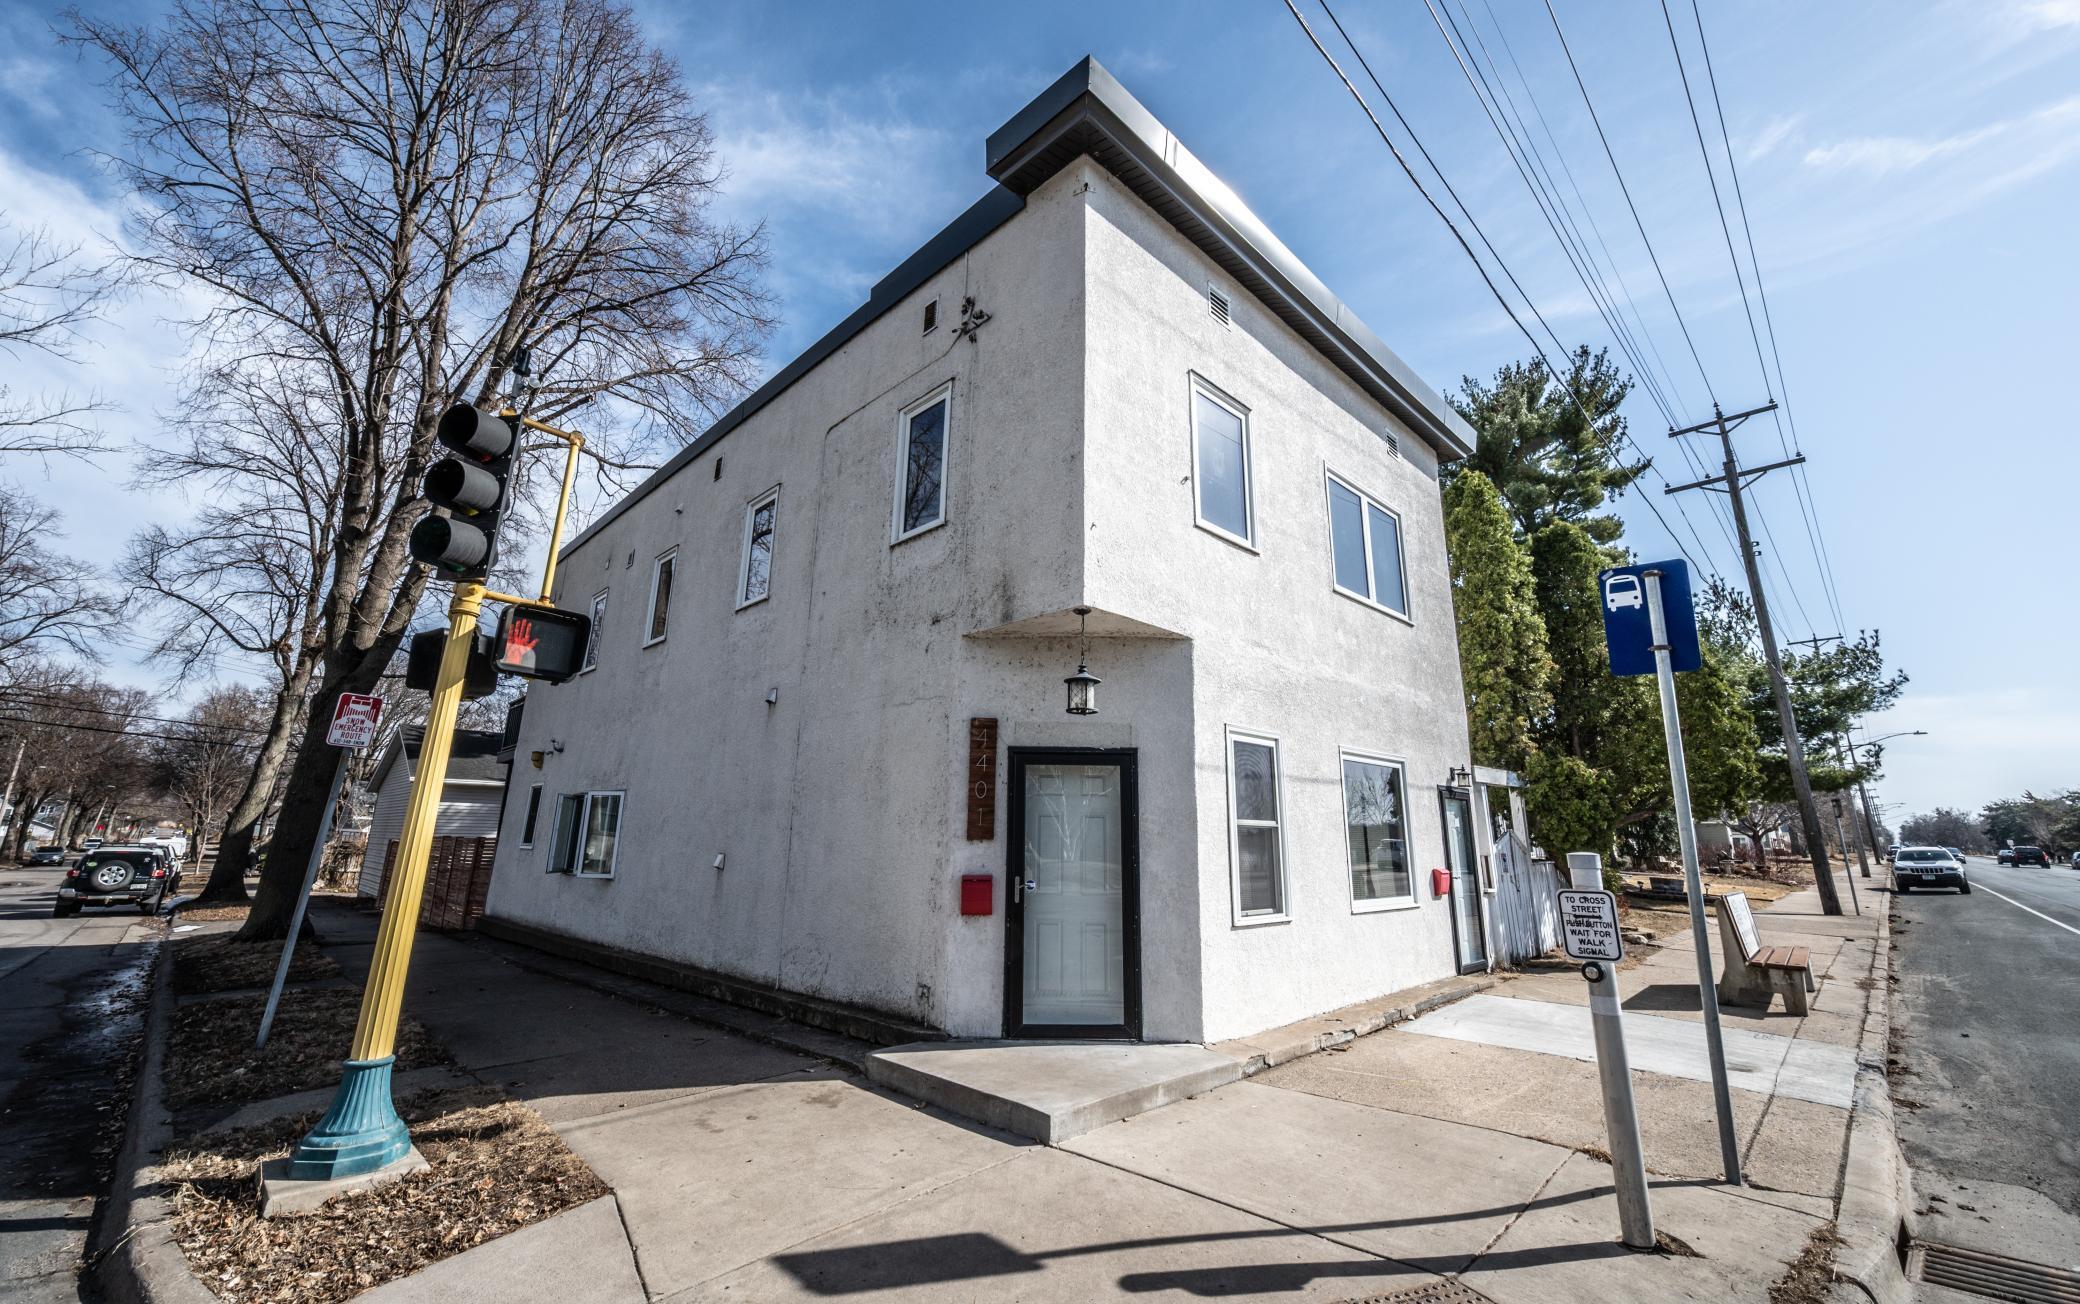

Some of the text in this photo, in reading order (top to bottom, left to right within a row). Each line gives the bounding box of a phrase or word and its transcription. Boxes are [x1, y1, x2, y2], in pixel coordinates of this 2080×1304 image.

[346, 717, 366, 725] SNOW
[335, 723, 372, 733] EMERGENCY
[341, 732, 362, 740] ROUTE
[975, 728, 988, 826] 4401
[1565, 896, 1606, 905] TO CROSS
[1571, 905, 1602, 913] STREET
[1570, 929, 1611, 938] WAIT FOR
[1578, 938, 1606, 947] WALK
[1578, 947, 1610, 956] SIGNAL
